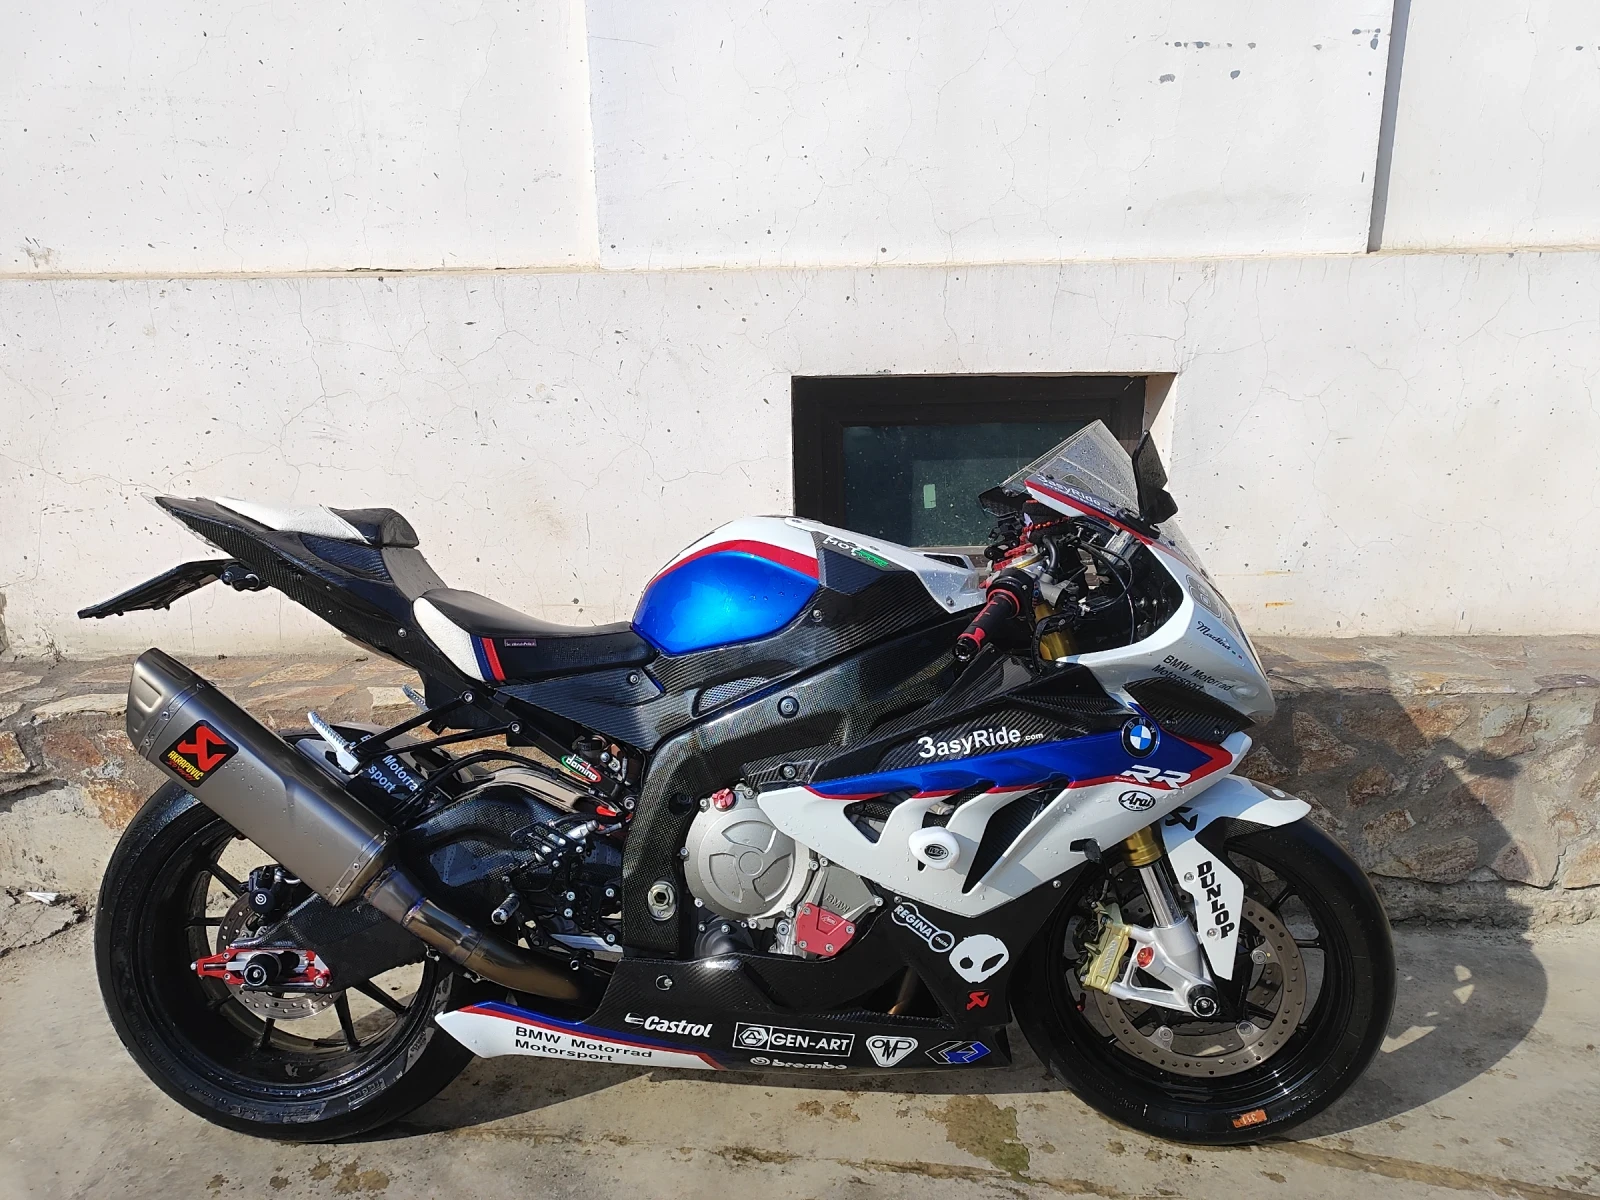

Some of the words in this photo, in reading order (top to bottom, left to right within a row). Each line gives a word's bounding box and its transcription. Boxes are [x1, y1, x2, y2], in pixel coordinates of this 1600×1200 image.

[1163, 655, 1193, 673] BMW
[1190, 669, 1234, 692] Motorrad
[382, 755, 418, 792] Motorra
[565, 754, 598, 781] domino
[1120, 764, 1191, 789] RR
[1121, 793, 1154, 807] Arai
[1197, 860, 1235, 938] DUNLOP
[893, 905, 933, 938] REGINA
[643, 1015, 713, 1038] Castrol
[515, 1026, 561, 1044] BMW
[571, 1038, 652, 1058] Motorrad
[515, 1039, 613, 1062] Motorsport
[771, 1033, 850, 1051] GEN-ART
[771, 1059, 848, 1070] brembo
